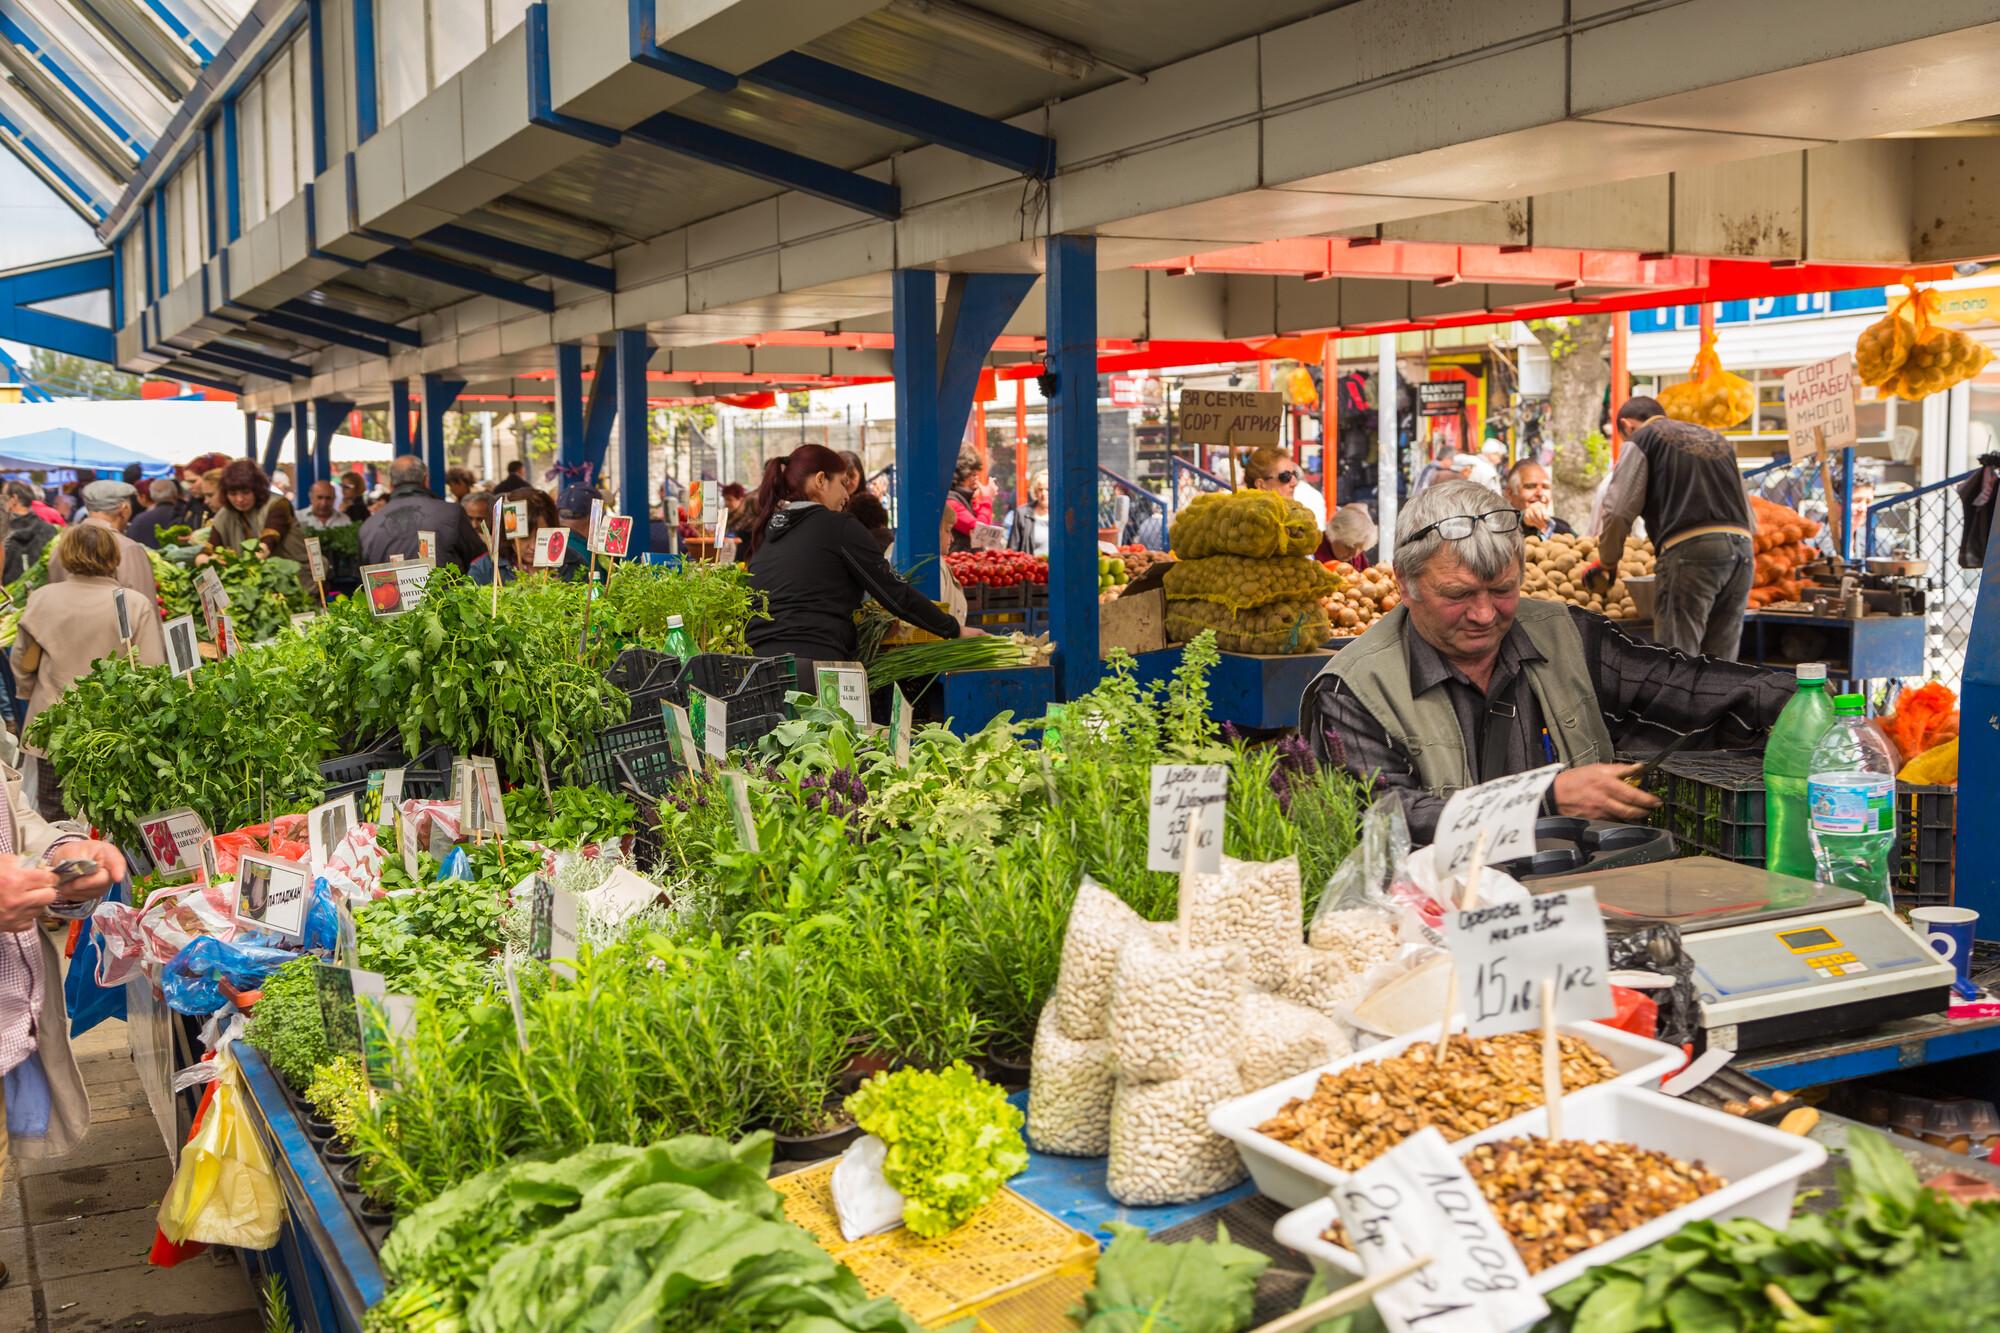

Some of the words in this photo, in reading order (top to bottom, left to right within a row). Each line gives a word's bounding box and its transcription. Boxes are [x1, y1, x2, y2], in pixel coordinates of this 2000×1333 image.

[1797, 358, 1837, 385] СОРТ
[1183, 391, 1199, 406] ЗА
[1204, 391, 1257, 408] СЕМЕ
[1789, 373, 1850, 408] МАРАБЕЛ
[1183, 413, 1222, 431] СОРТ
[1229, 415, 1281, 432] АГРИЯ
[1797, 398, 1843, 424] МНОГО
[1795, 415, 1850, 447] ВКСНИ
[172, 826, 201, 840] ЧЕРВЕНО
[267, 886, 302, 908] ПАТЛАДЖАН
[1419, 1171, 1520, 1294] лапад
